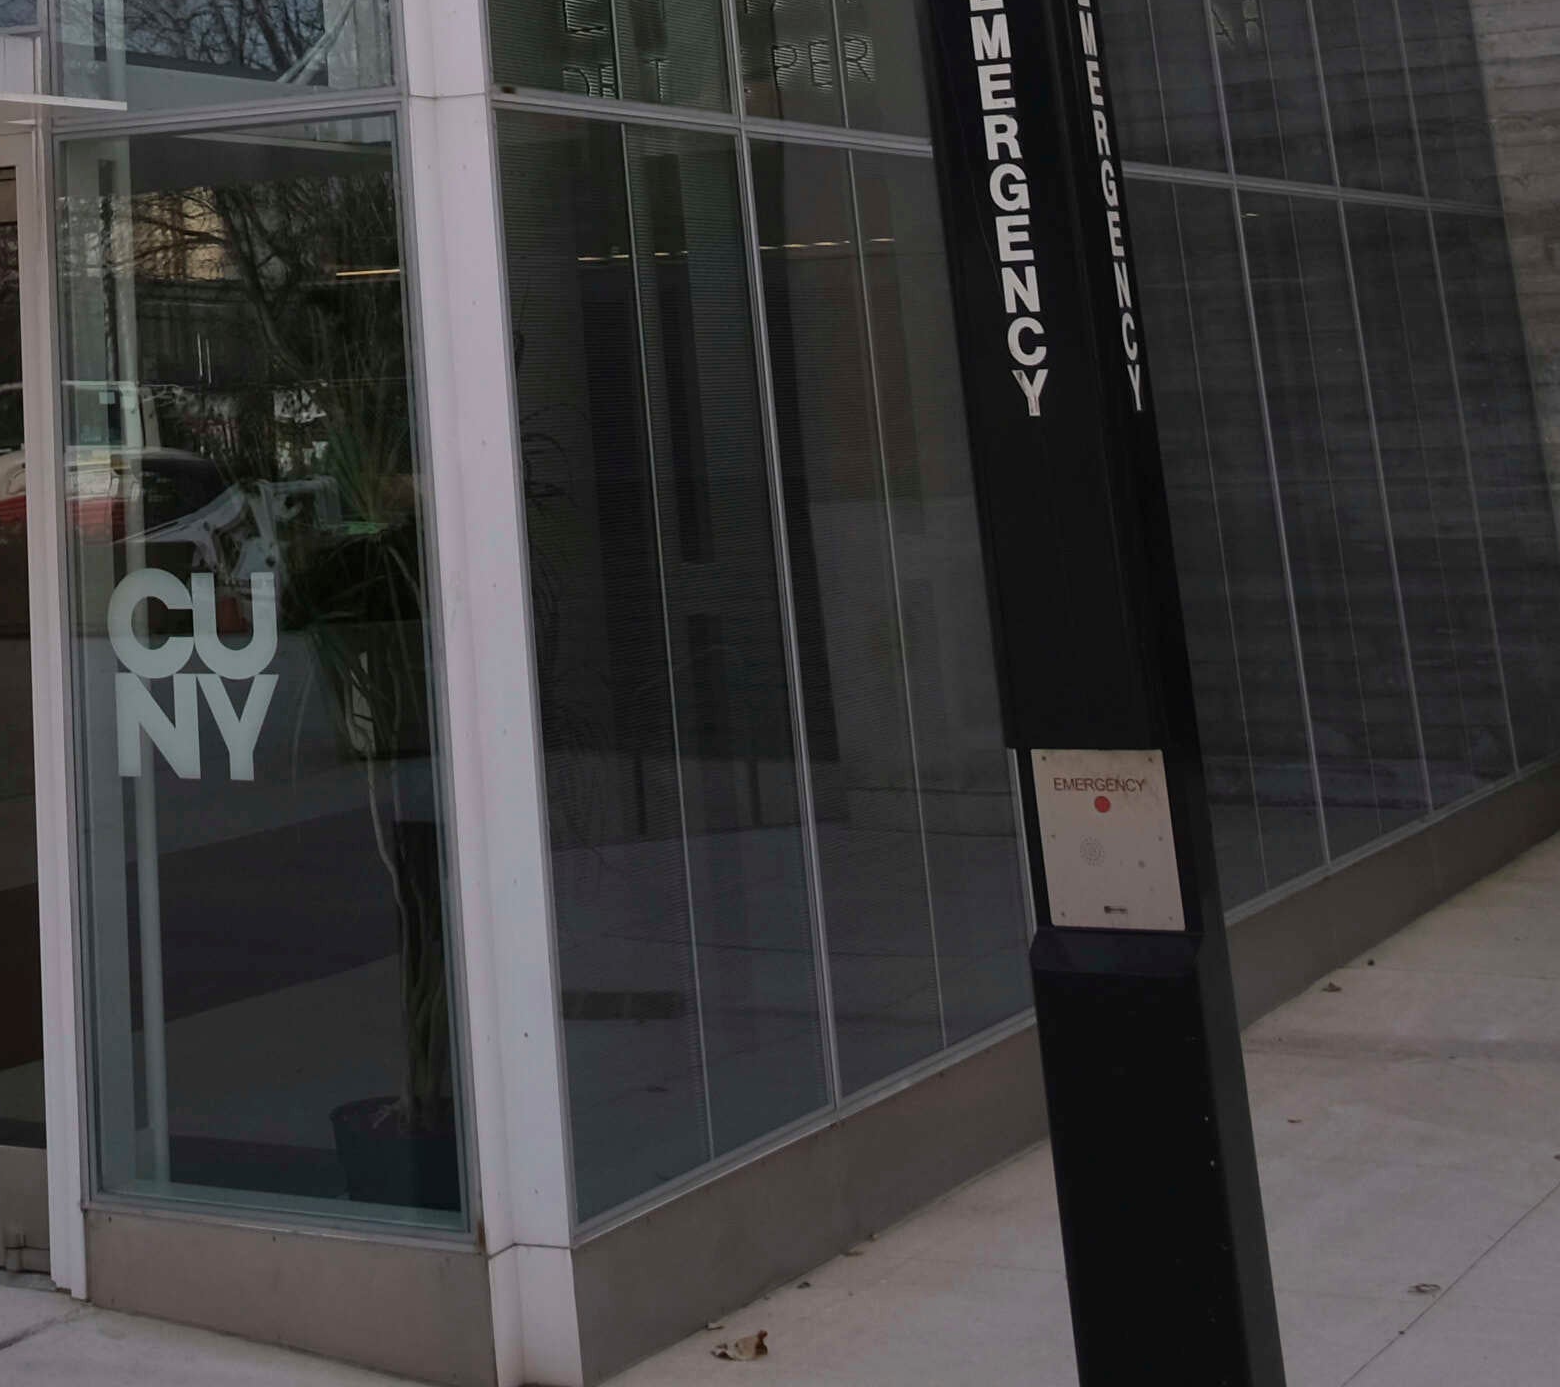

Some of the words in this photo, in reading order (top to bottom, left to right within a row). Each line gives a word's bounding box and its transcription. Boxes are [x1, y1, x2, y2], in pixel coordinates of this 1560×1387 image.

[106, 567, 279, 680] CU
[114, 671, 280, 781] NY
[1053, 776, 1147, 793] EMERGENCY
